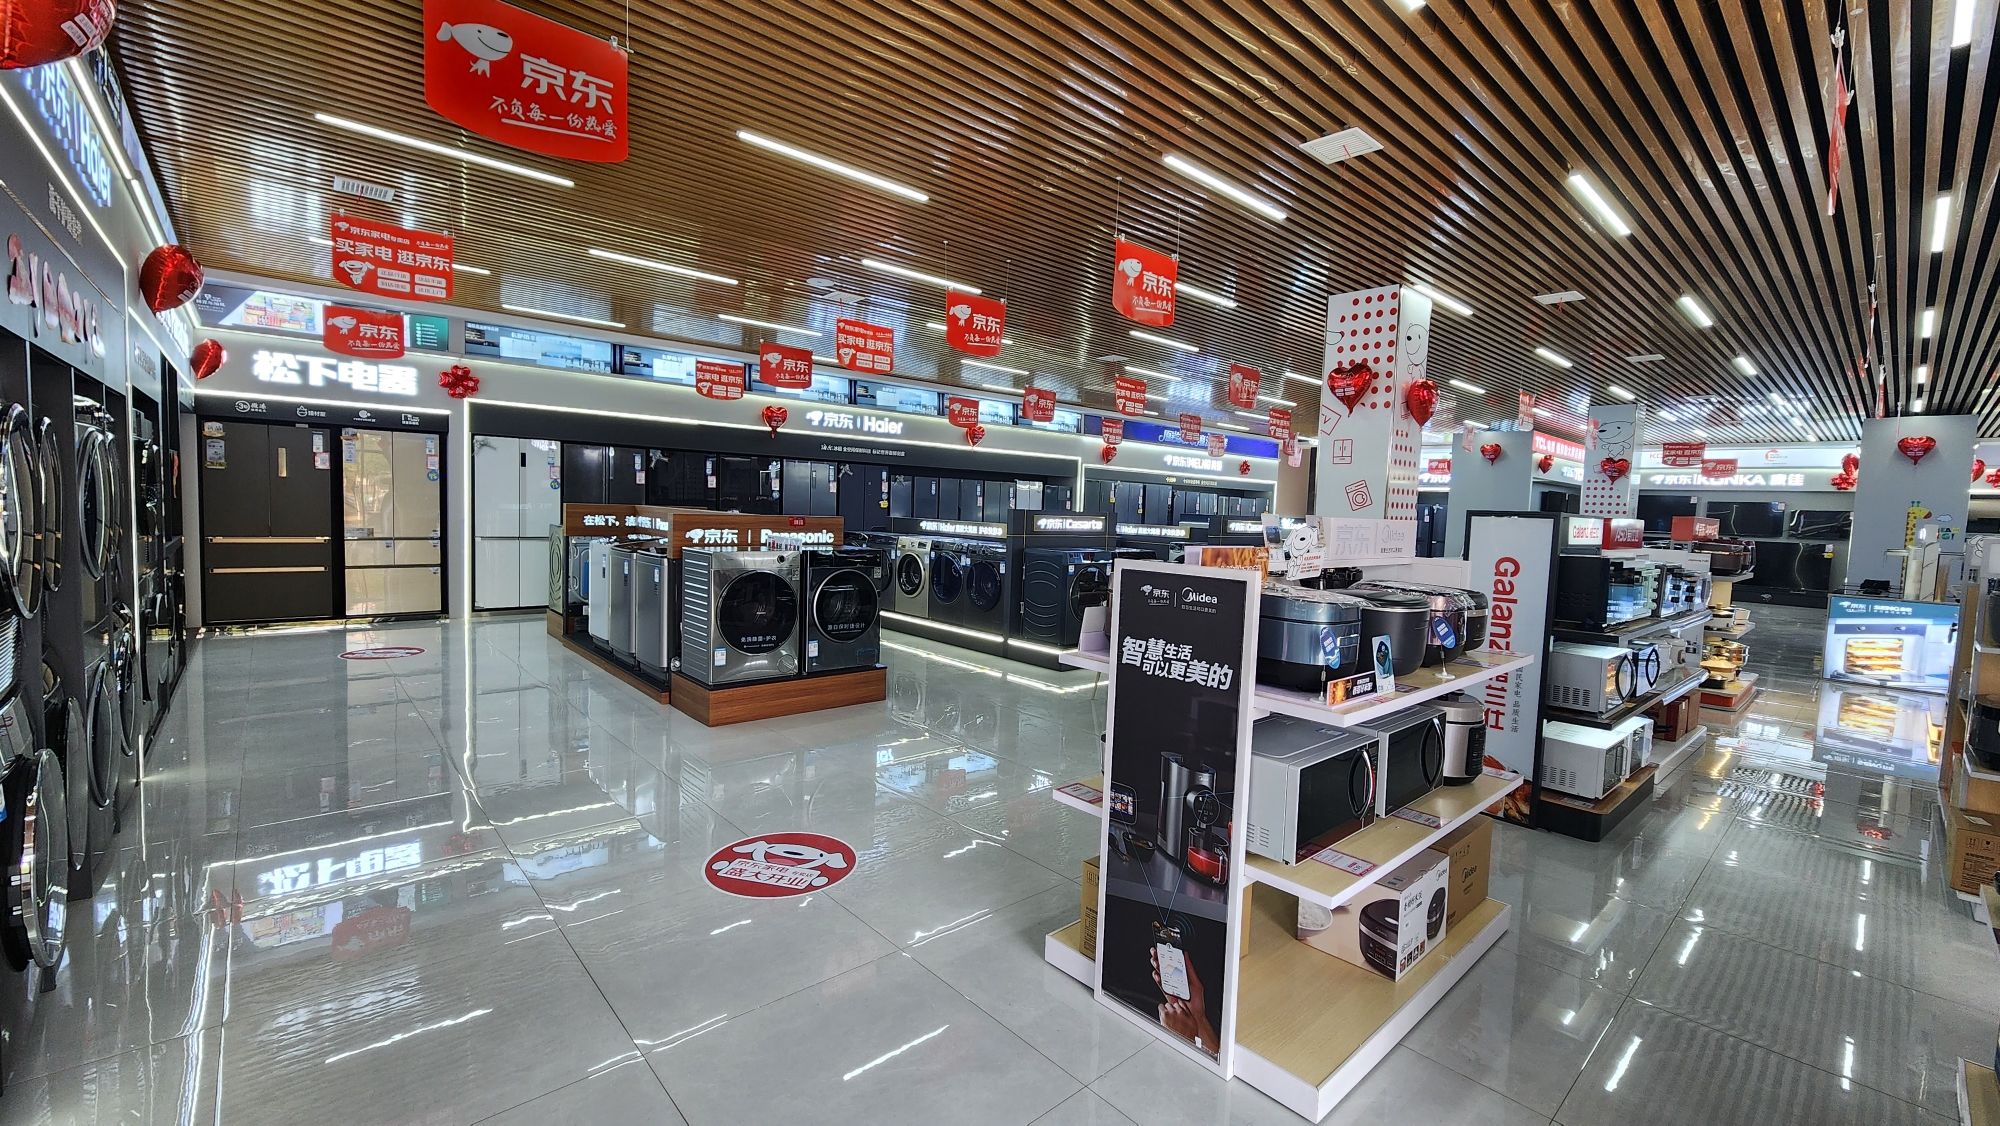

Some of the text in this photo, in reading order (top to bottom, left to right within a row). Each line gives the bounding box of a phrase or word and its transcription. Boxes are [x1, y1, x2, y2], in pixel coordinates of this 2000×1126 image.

[519, 53, 614, 115] 京东
[488, 96, 618, 139] 不负每一份热爱
[80, 119, 112, 207] Haier
[336, 237, 451, 272] 买家电 逛京东
[1141, 270, 1172, 299] 京东
[359, 323, 399, 341] 京东
[972, 313, 1001, 334] 京东
[837, 333, 866, 347] 买家电
[866, 338, 893, 353] 逛京东
[252, 350, 419, 397] 松下电器
[783, 358, 809, 373] 京东
[696, 371, 720, 383] 买家电
[961, 406, 977, 417] 京东
[1038, 399, 1054, 410] 京东
[822, 411, 904, 436] 京东 Haier
[1716, 464, 1735, 472] 京东
[1663, 474, 1694, 487] 京东
[1696, 474, 1767, 487] KONKA
[1046, 518, 1103, 530] 京东 Casarte
[702, 528, 739, 544] 京东
[1152, 586, 1218, 605] 京东 Midea
[1489, 556, 1521, 653] Galanz
[1121, 635, 1193, 668] 智慧生活
[1142, 658, 1234, 690] 可以更美的
[1510, 700, 1521, 733] 品质生活
[723, 867, 809, 888] 盛大开业
[737, 860, 790, 874] 京东家电
